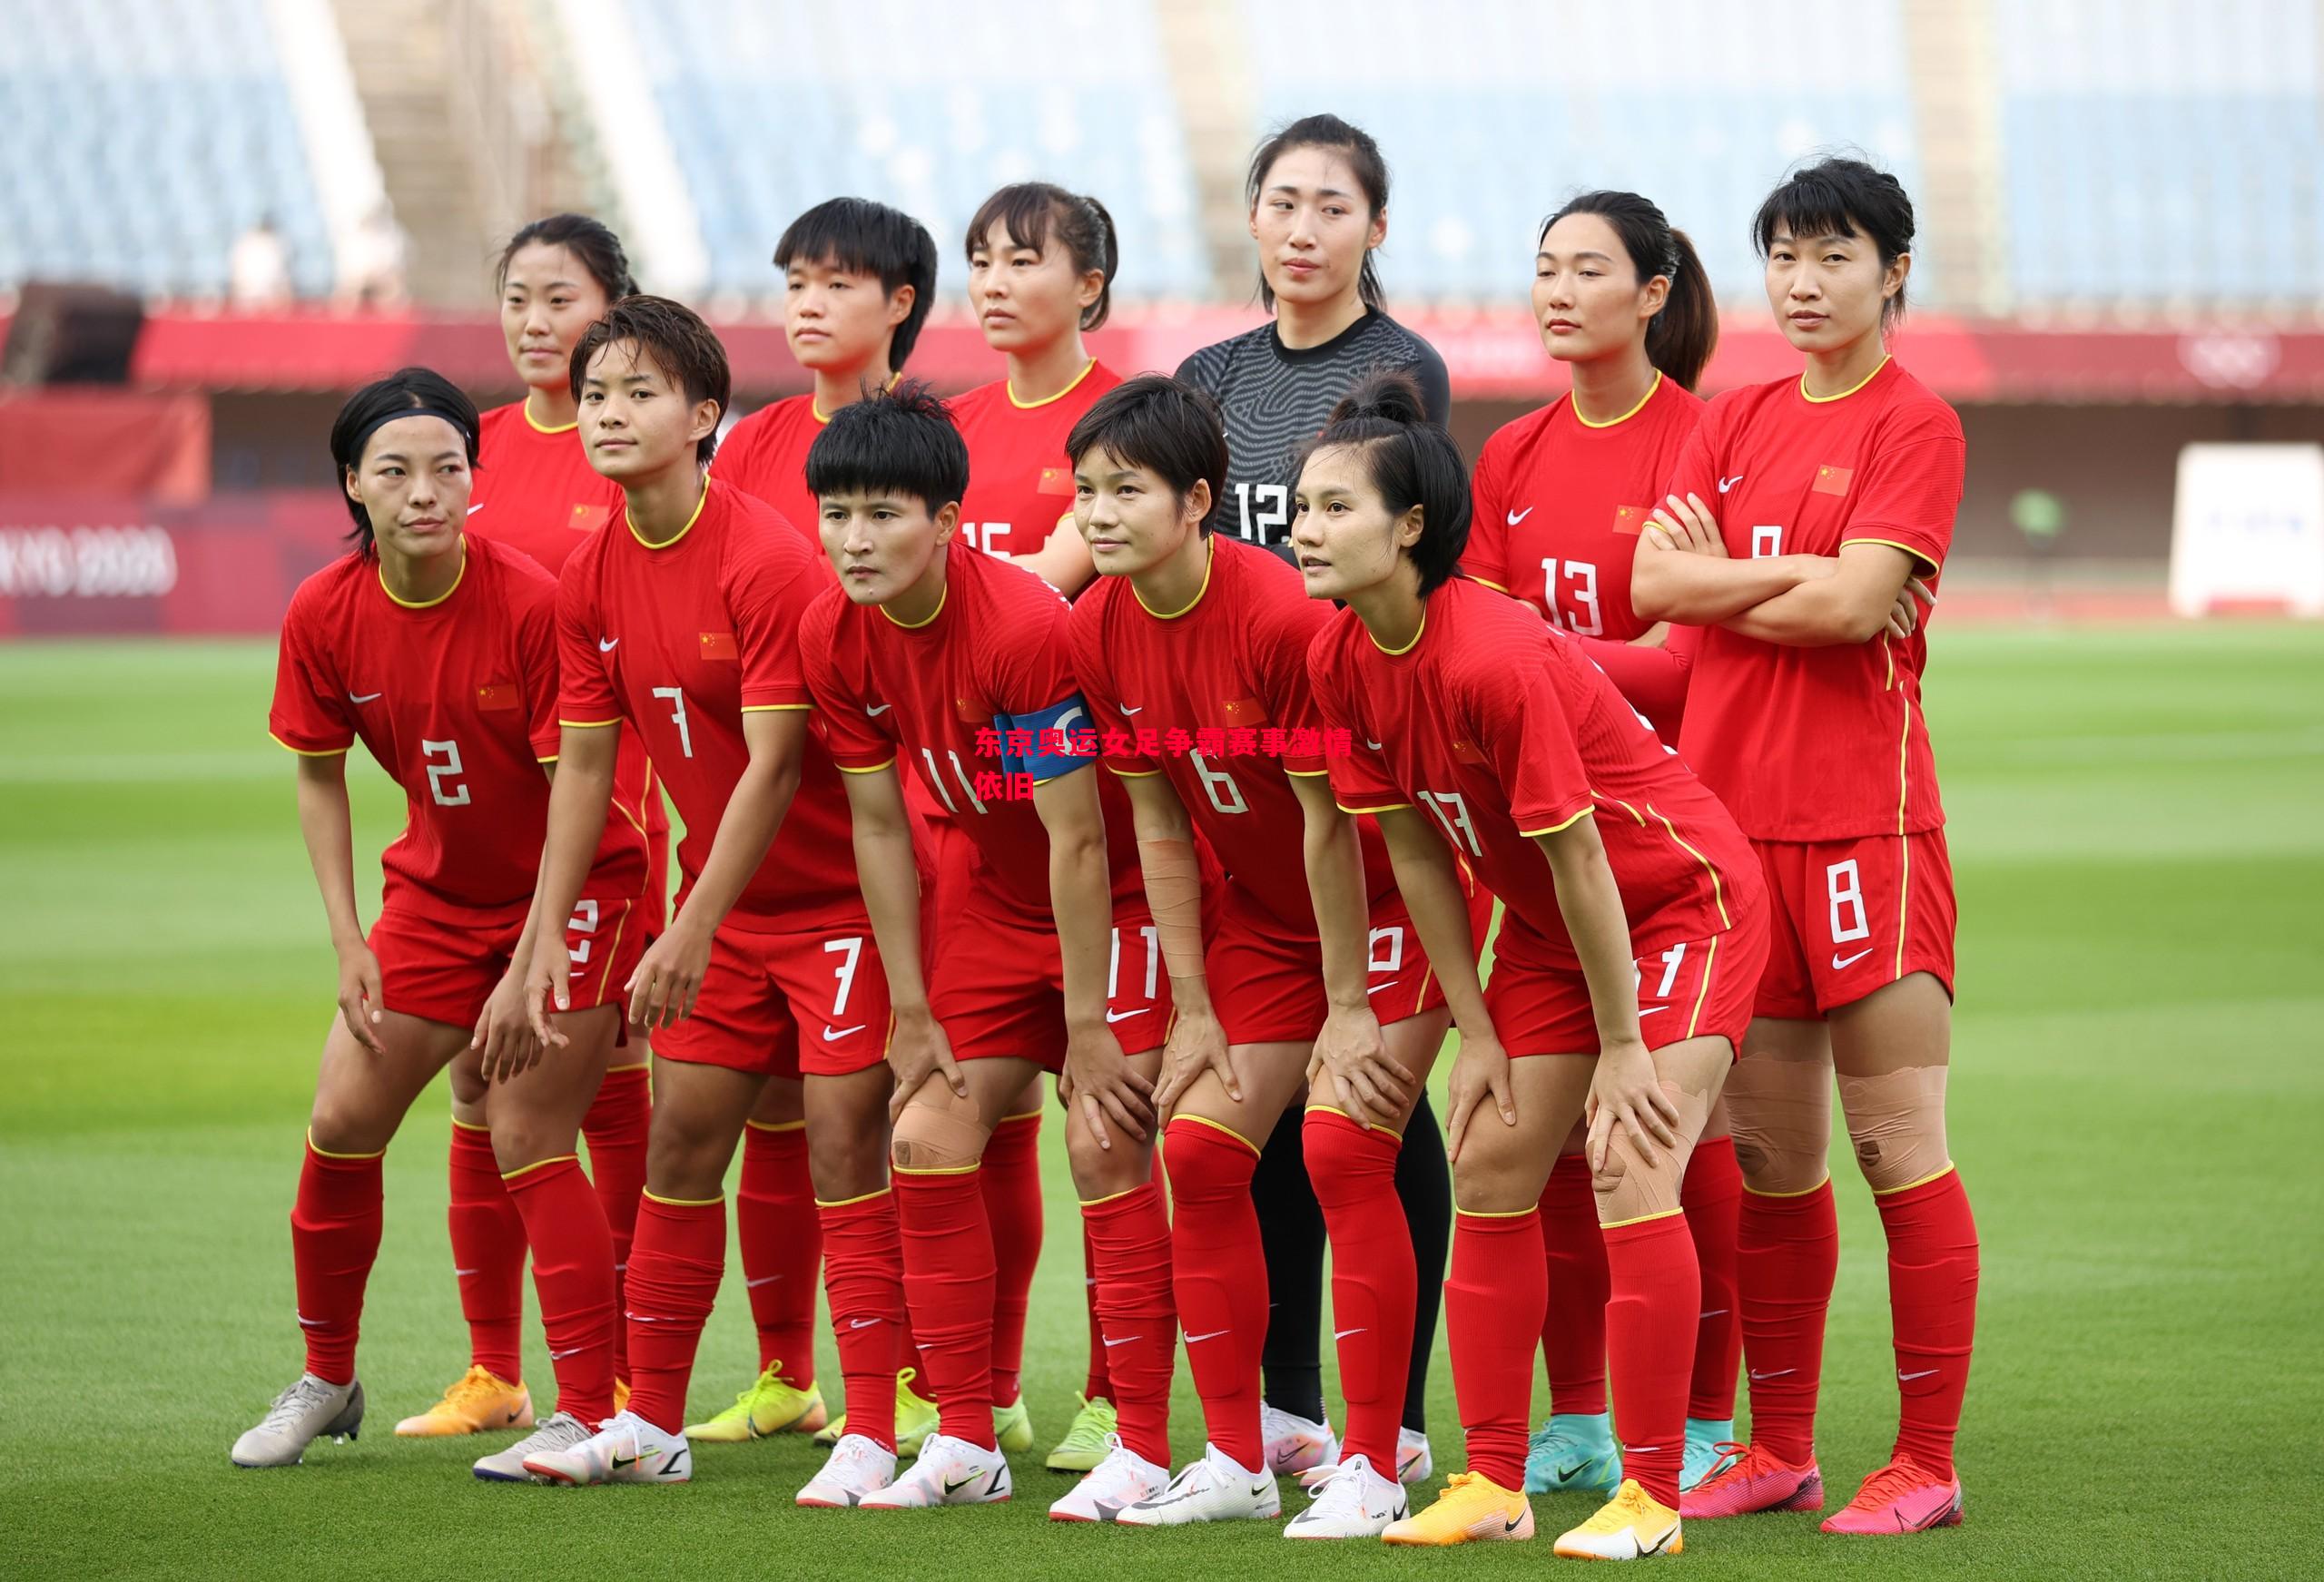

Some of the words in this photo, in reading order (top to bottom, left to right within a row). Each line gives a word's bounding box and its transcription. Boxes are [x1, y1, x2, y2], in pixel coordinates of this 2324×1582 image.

[1235, 483, 1290, 545] 12
[1541, 557, 1603, 636] 13
[653, 687, 693, 758] 7
[422, 740, 470, 806] 2
[921, 748, 988, 814] 11
[1189, 746, 1249, 813] 6
[1417, 791, 1482, 857] 17
[568, 899, 598, 963] 2
[1827, 860, 1869, 943] 8
[824, 937, 862, 1015] 7
[1108, 926, 1158, 998] 11
